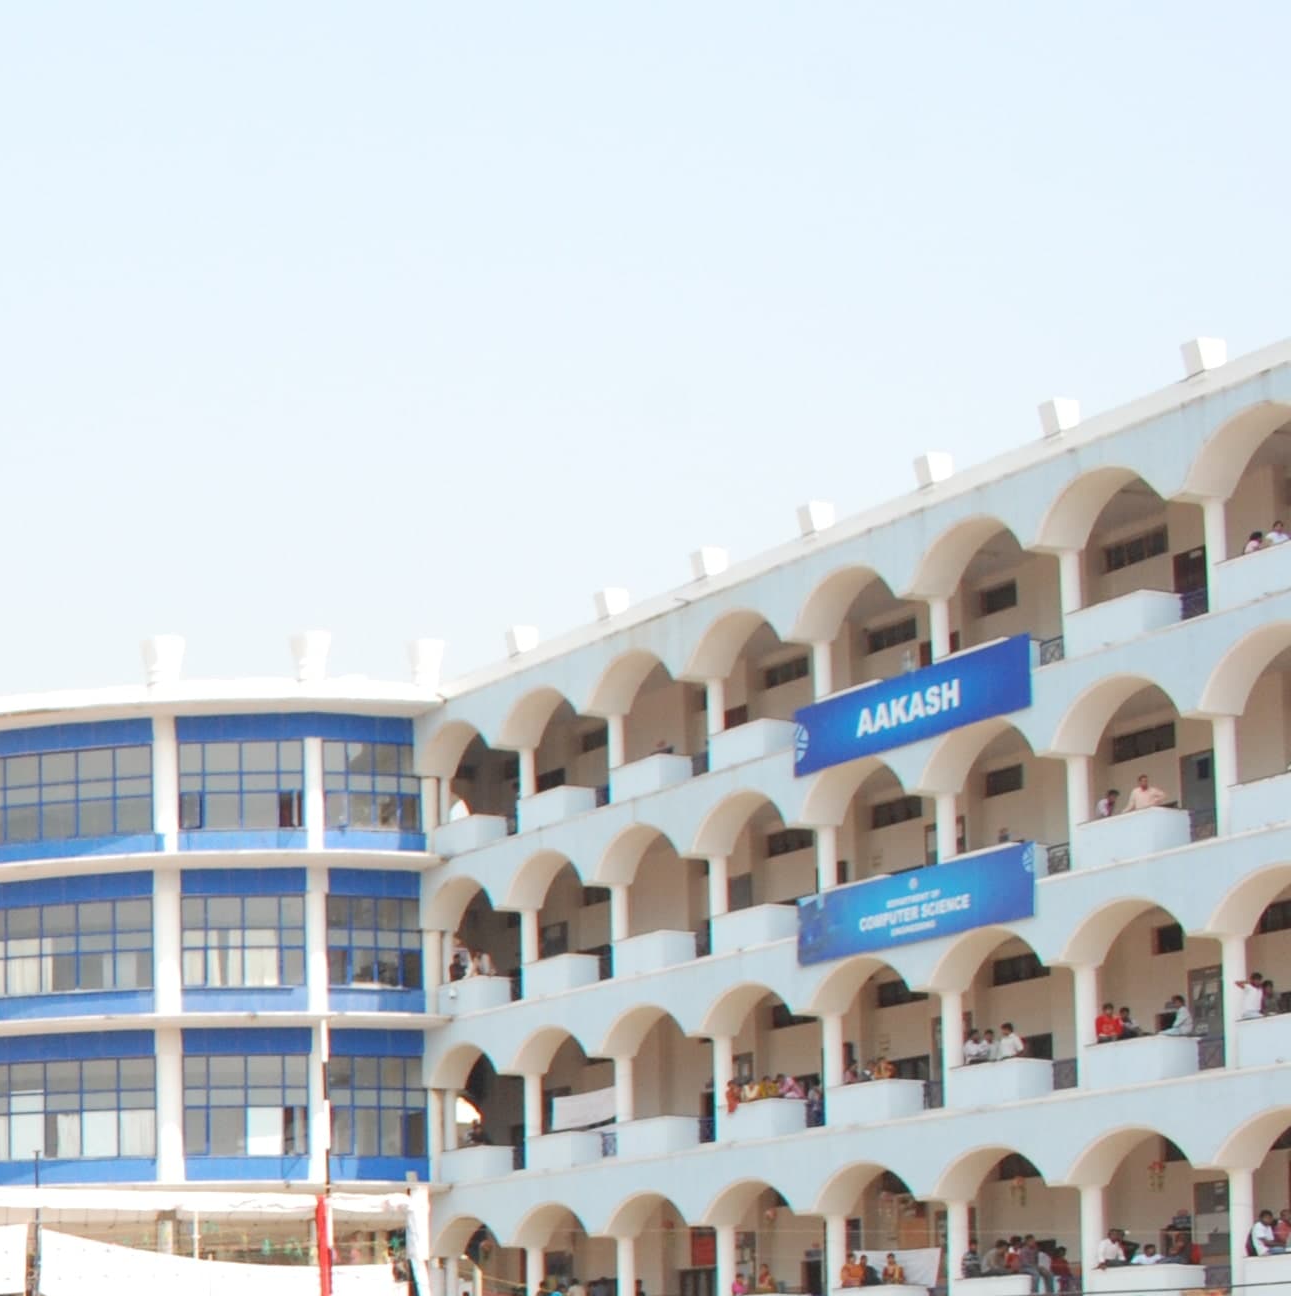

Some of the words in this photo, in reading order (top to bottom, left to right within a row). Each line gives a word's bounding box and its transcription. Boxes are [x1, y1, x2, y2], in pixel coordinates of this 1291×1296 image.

[856, 679, 961, 737] AAKASH
[859, 905, 919, 932] COMPUTER
[921, 893, 971, 918] SCIENCE
